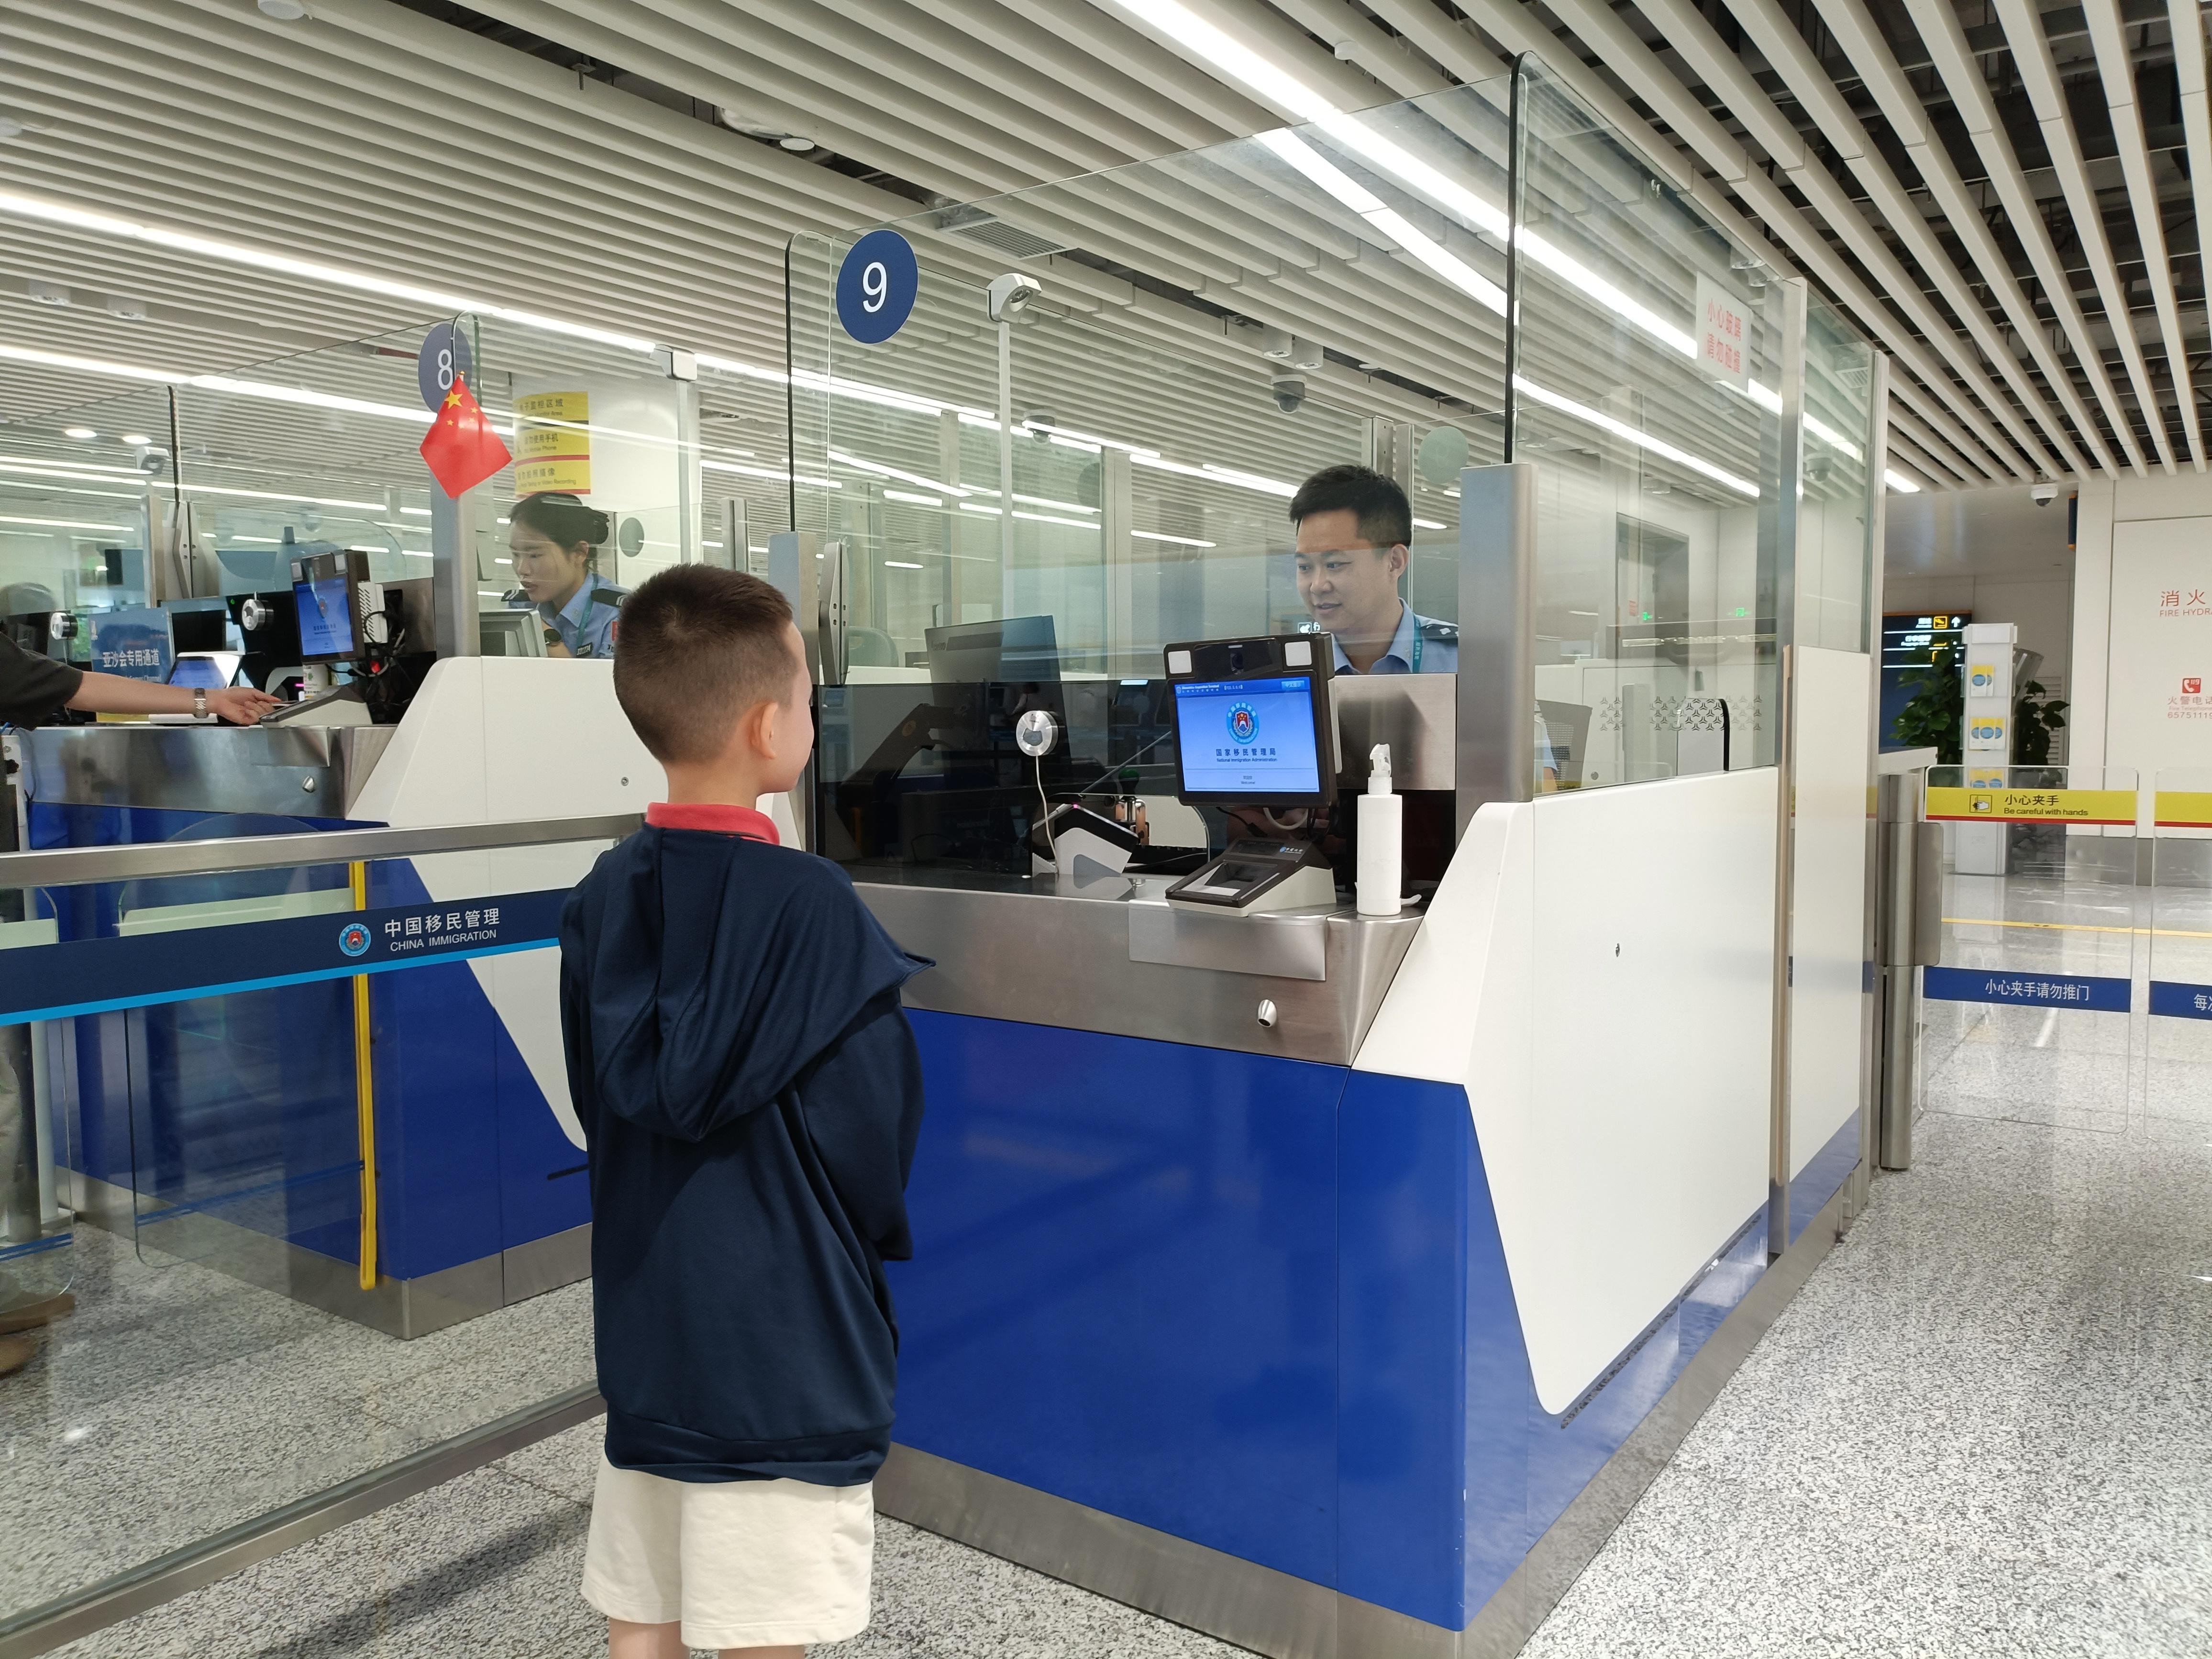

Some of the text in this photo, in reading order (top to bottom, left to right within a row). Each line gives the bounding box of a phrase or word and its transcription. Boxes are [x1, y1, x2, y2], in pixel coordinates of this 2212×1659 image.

[863, 262, 887, 312] 9
[438, 349, 454, 390] 8
[2159, 608, 2212, 617] FIRE HYDR
[102, 649, 160, 668] 亚沙会专用通道
[1216, 748, 1276, 756] 国家移民管理局
[2005, 794, 2059, 806] 小心夹手
[385, 908, 500, 938] 中国移民管理
[390, 929, 497, 951] CHINA IMMIGRATION
[1985, 978, 2090, 1001] 小心夹手请勿推门
